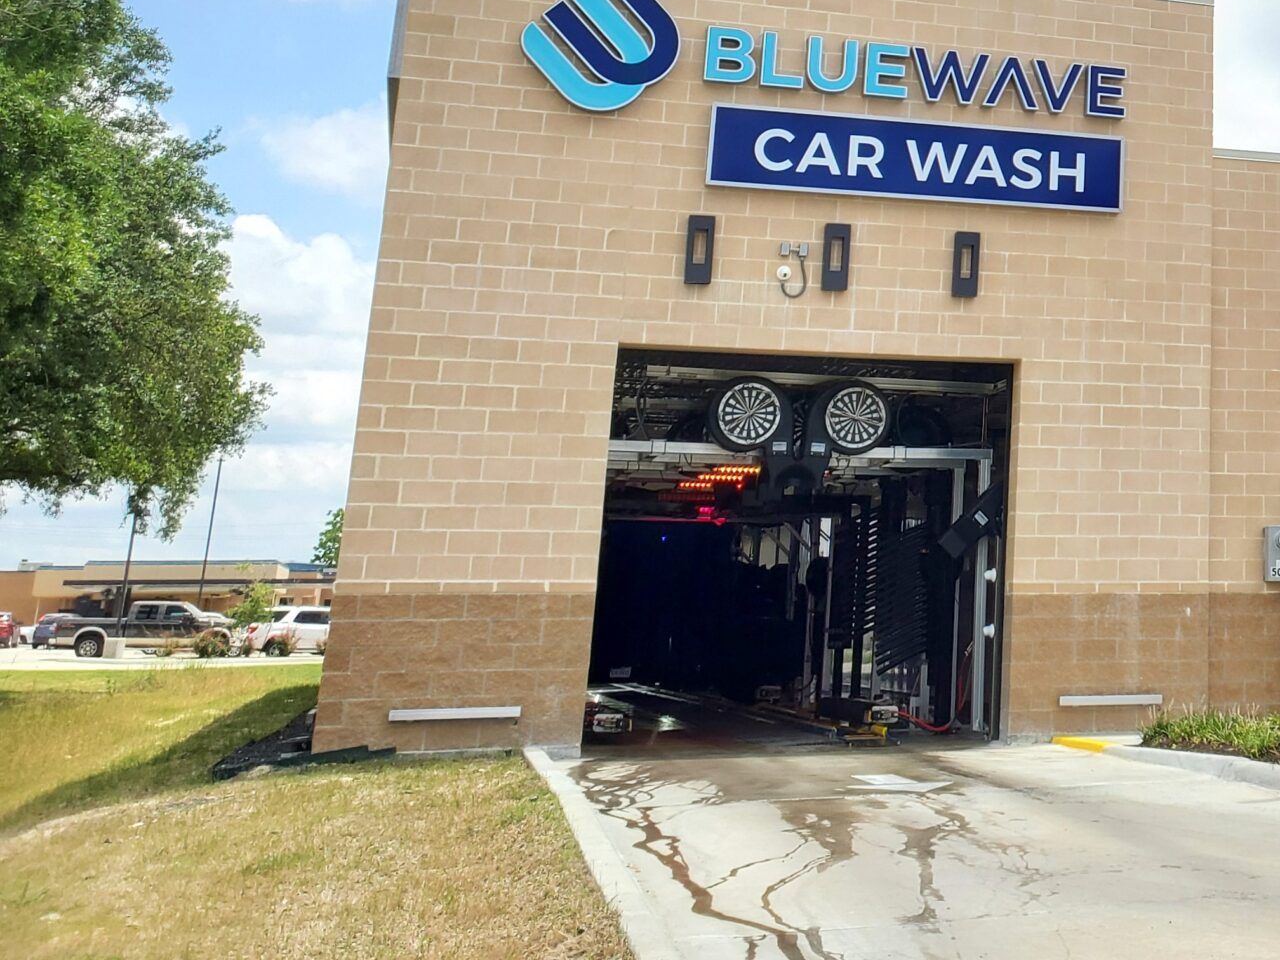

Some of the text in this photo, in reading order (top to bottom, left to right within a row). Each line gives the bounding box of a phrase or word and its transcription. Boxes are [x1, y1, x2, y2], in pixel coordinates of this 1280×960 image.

[703, 24, 1127, 118] BLUEWAVE
[753, 127, 1087, 194] CAR WASH
